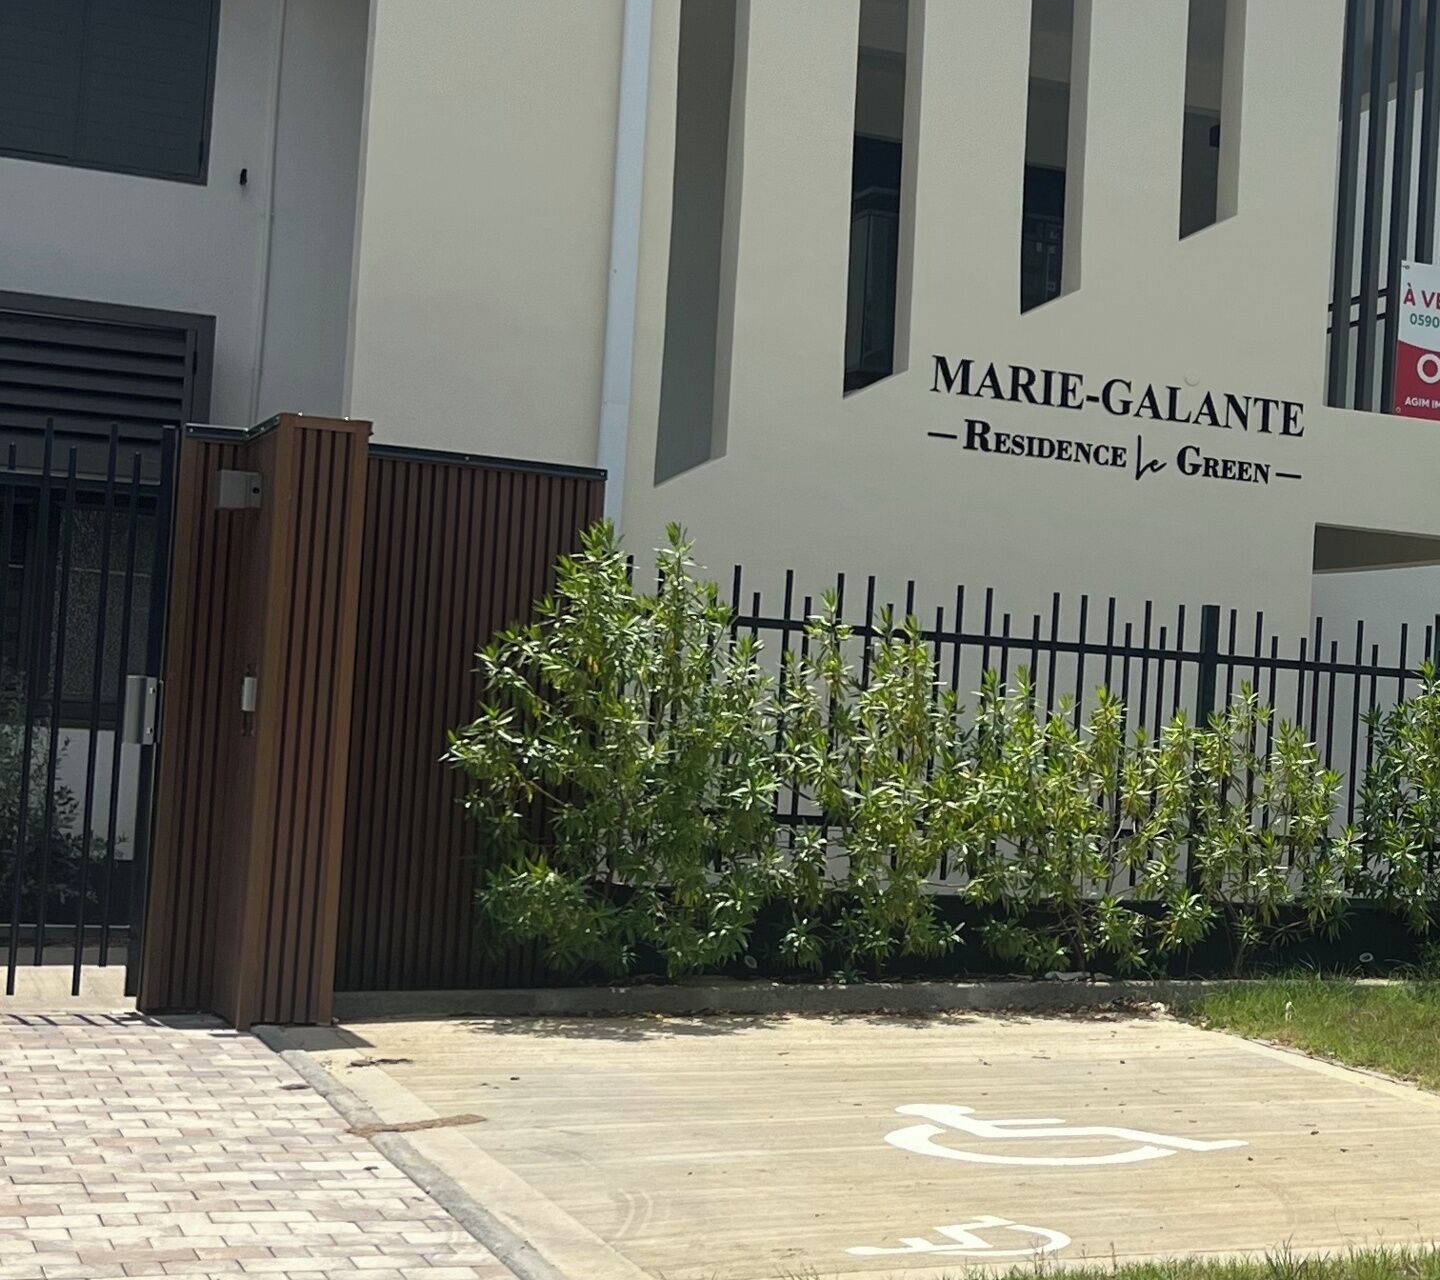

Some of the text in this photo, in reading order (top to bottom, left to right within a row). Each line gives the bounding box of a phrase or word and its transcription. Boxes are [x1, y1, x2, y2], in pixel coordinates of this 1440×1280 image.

[1403, 282, 1416, 306] À
[1410, 313, 1440, 329] 0590
[930, 355, 1304, 438] MARIE-GALANTE
[1405, 396, 1430, 408] AGIM
